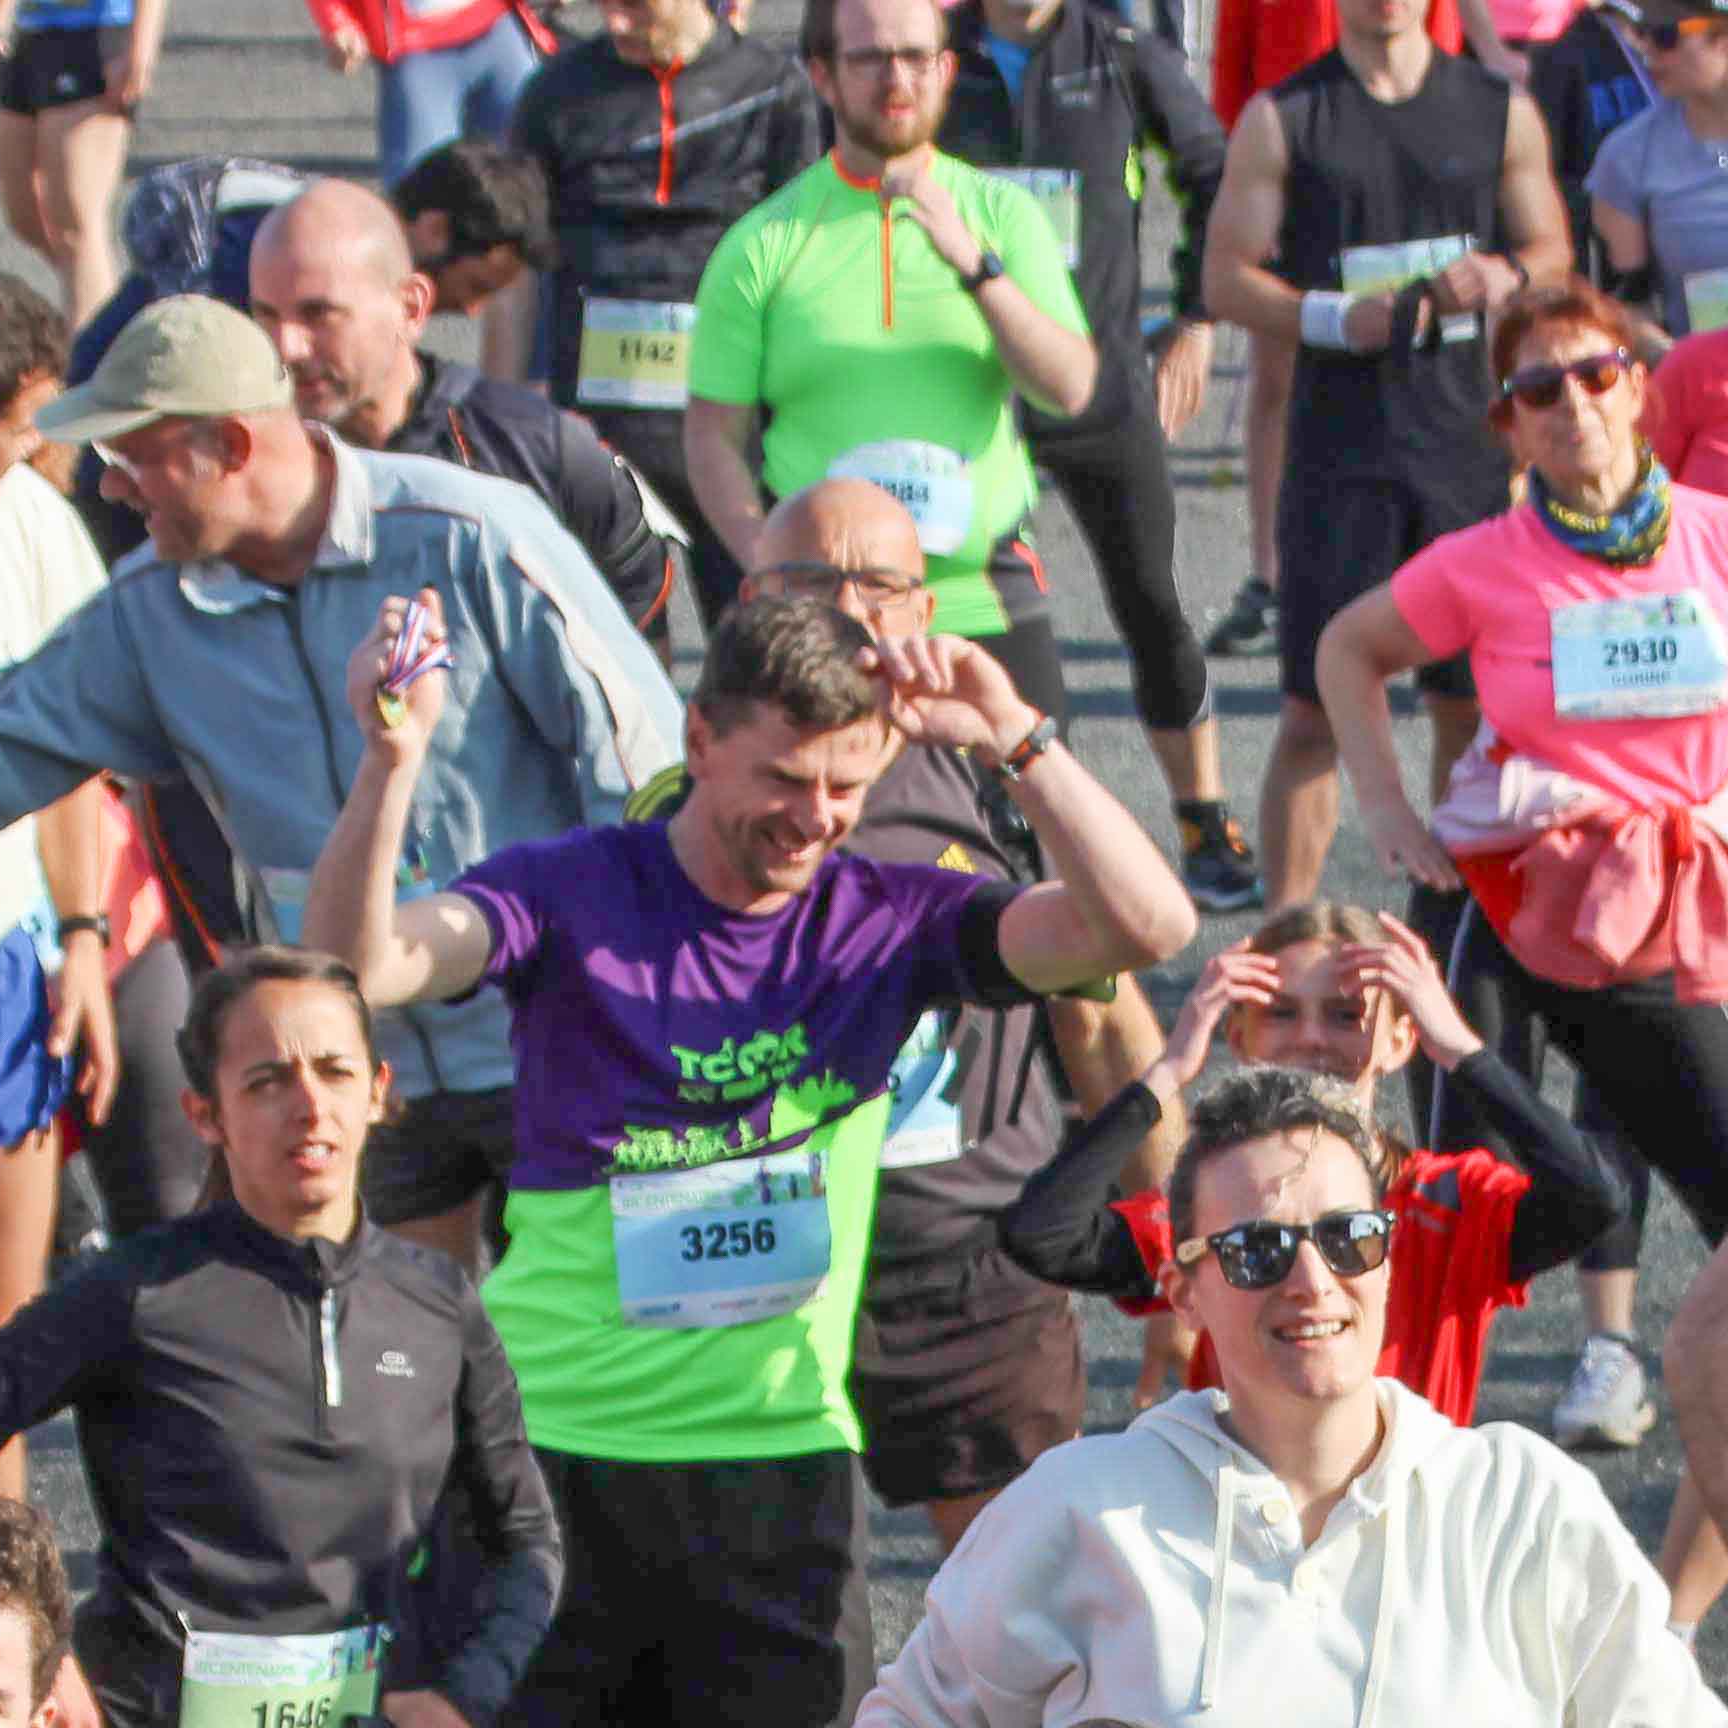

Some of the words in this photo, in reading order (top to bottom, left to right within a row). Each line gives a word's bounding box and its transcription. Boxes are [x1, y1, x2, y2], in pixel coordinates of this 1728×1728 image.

[619, 338, 675, 364] 1142
[1603, 635, 1678, 668] 2930
[680, 1217, 776, 1263] 3256
